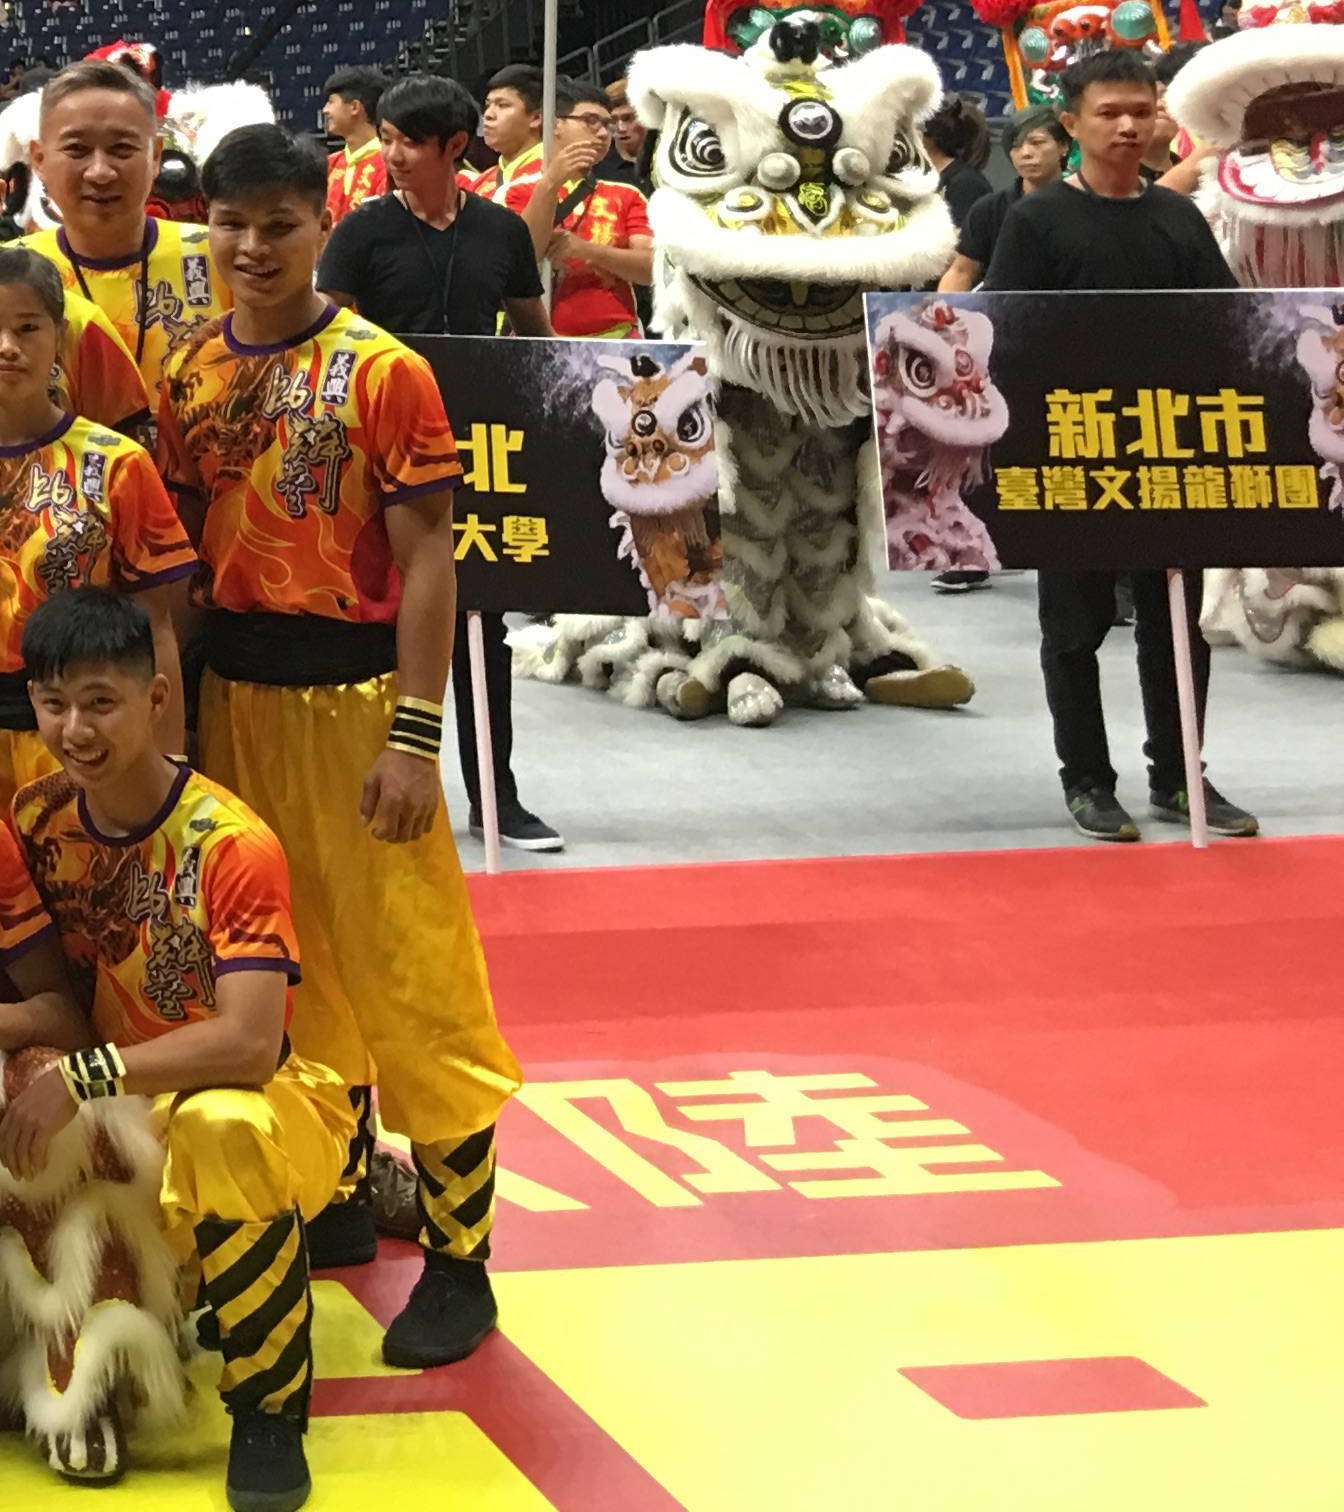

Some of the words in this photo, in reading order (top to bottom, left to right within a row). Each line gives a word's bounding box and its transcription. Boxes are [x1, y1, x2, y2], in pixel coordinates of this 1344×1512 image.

[1045, 388, 1268, 459] 新北市
[995, 464, 1320, 511] 臺灣文揚龍獅團
